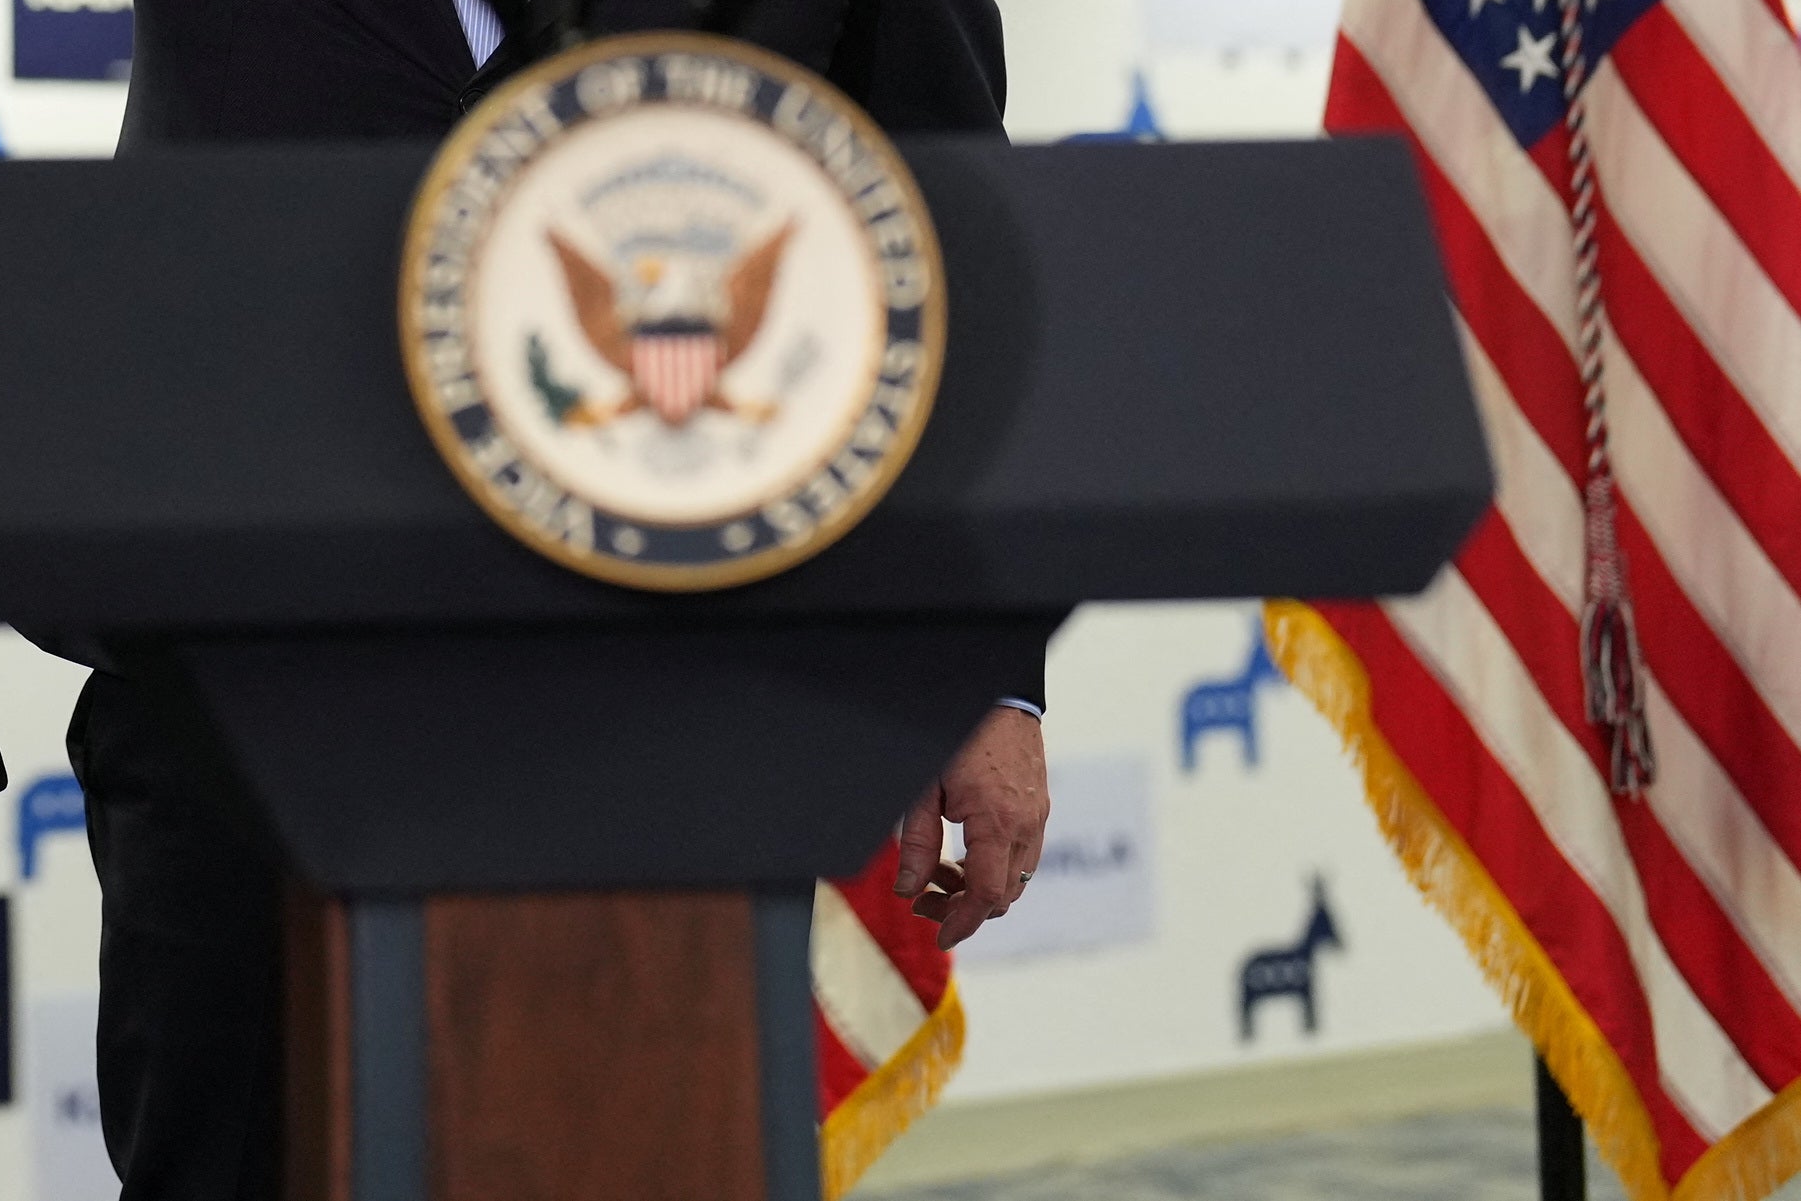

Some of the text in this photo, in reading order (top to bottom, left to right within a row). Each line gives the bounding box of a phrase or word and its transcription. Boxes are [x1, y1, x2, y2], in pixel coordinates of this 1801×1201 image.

[422, 54, 930, 551] VICE PRESIDENT OF THE UNITED STATES
